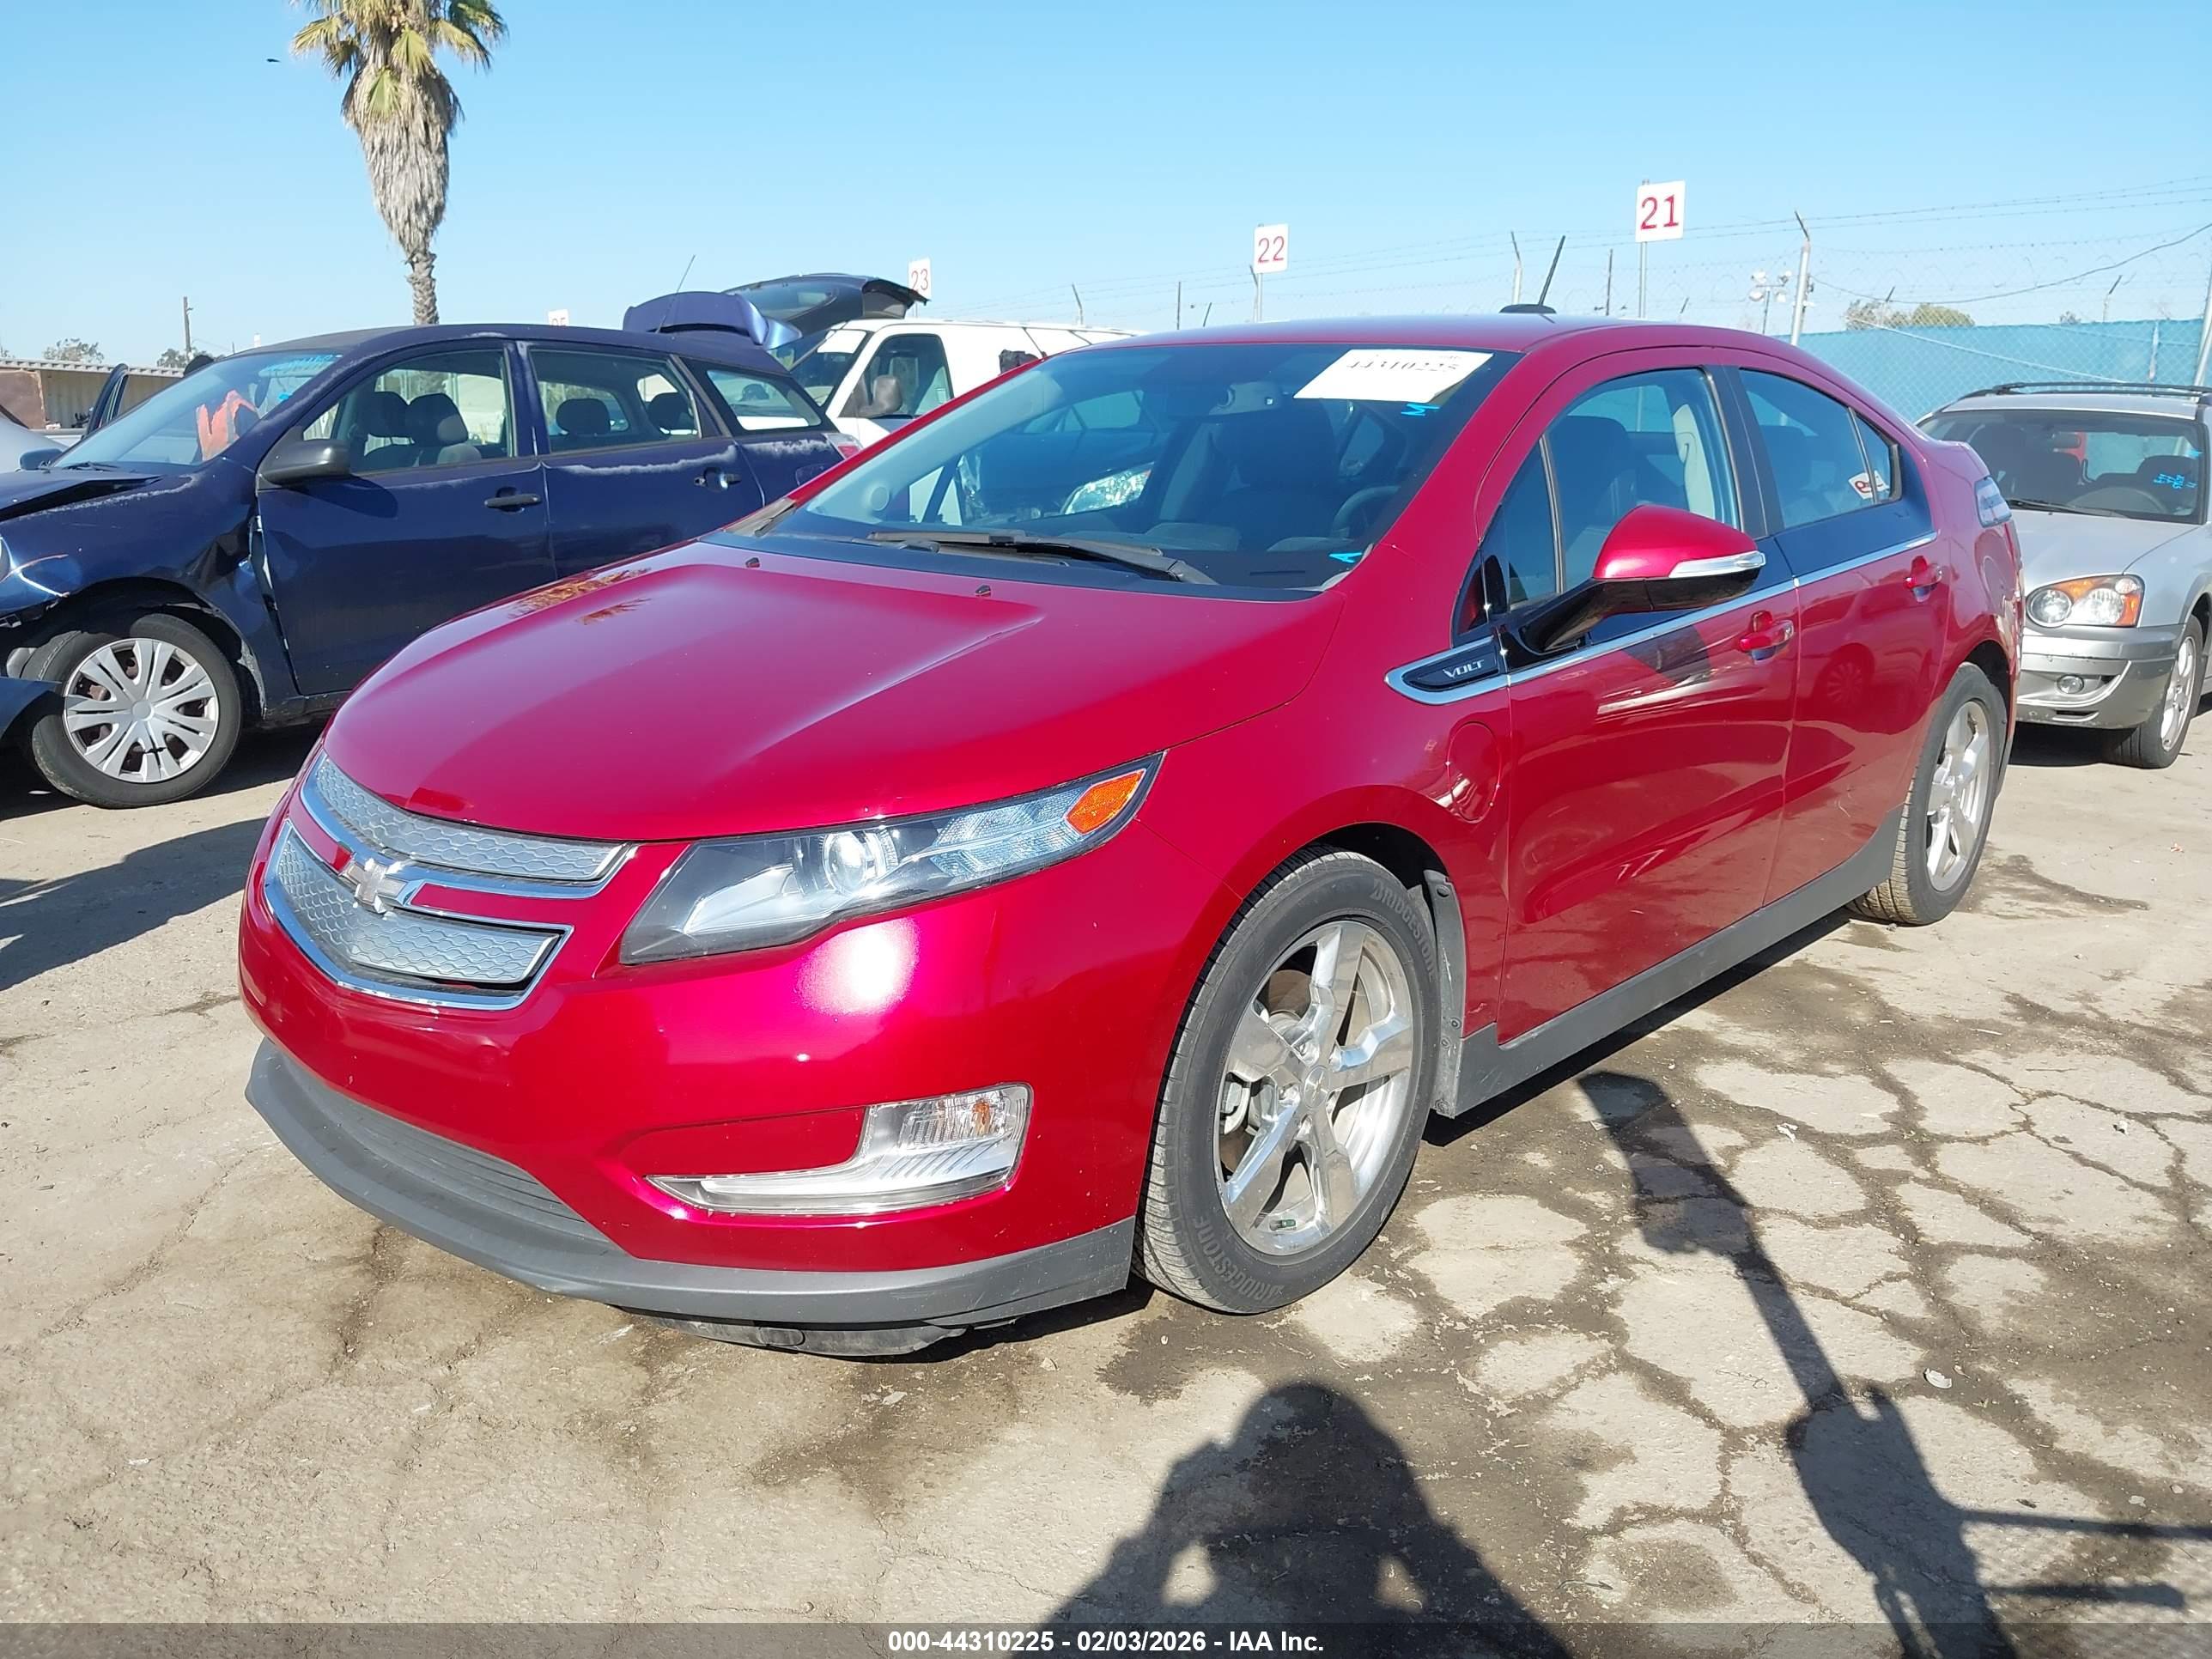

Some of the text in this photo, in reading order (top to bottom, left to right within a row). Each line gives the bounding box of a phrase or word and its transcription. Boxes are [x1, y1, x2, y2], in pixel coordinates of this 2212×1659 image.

[1640, 194, 1680, 230] 21
[1258, 235, 1285, 264] 22
[911, 268, 929, 291] 23
[1442, 659, 1485, 679] VOLT
